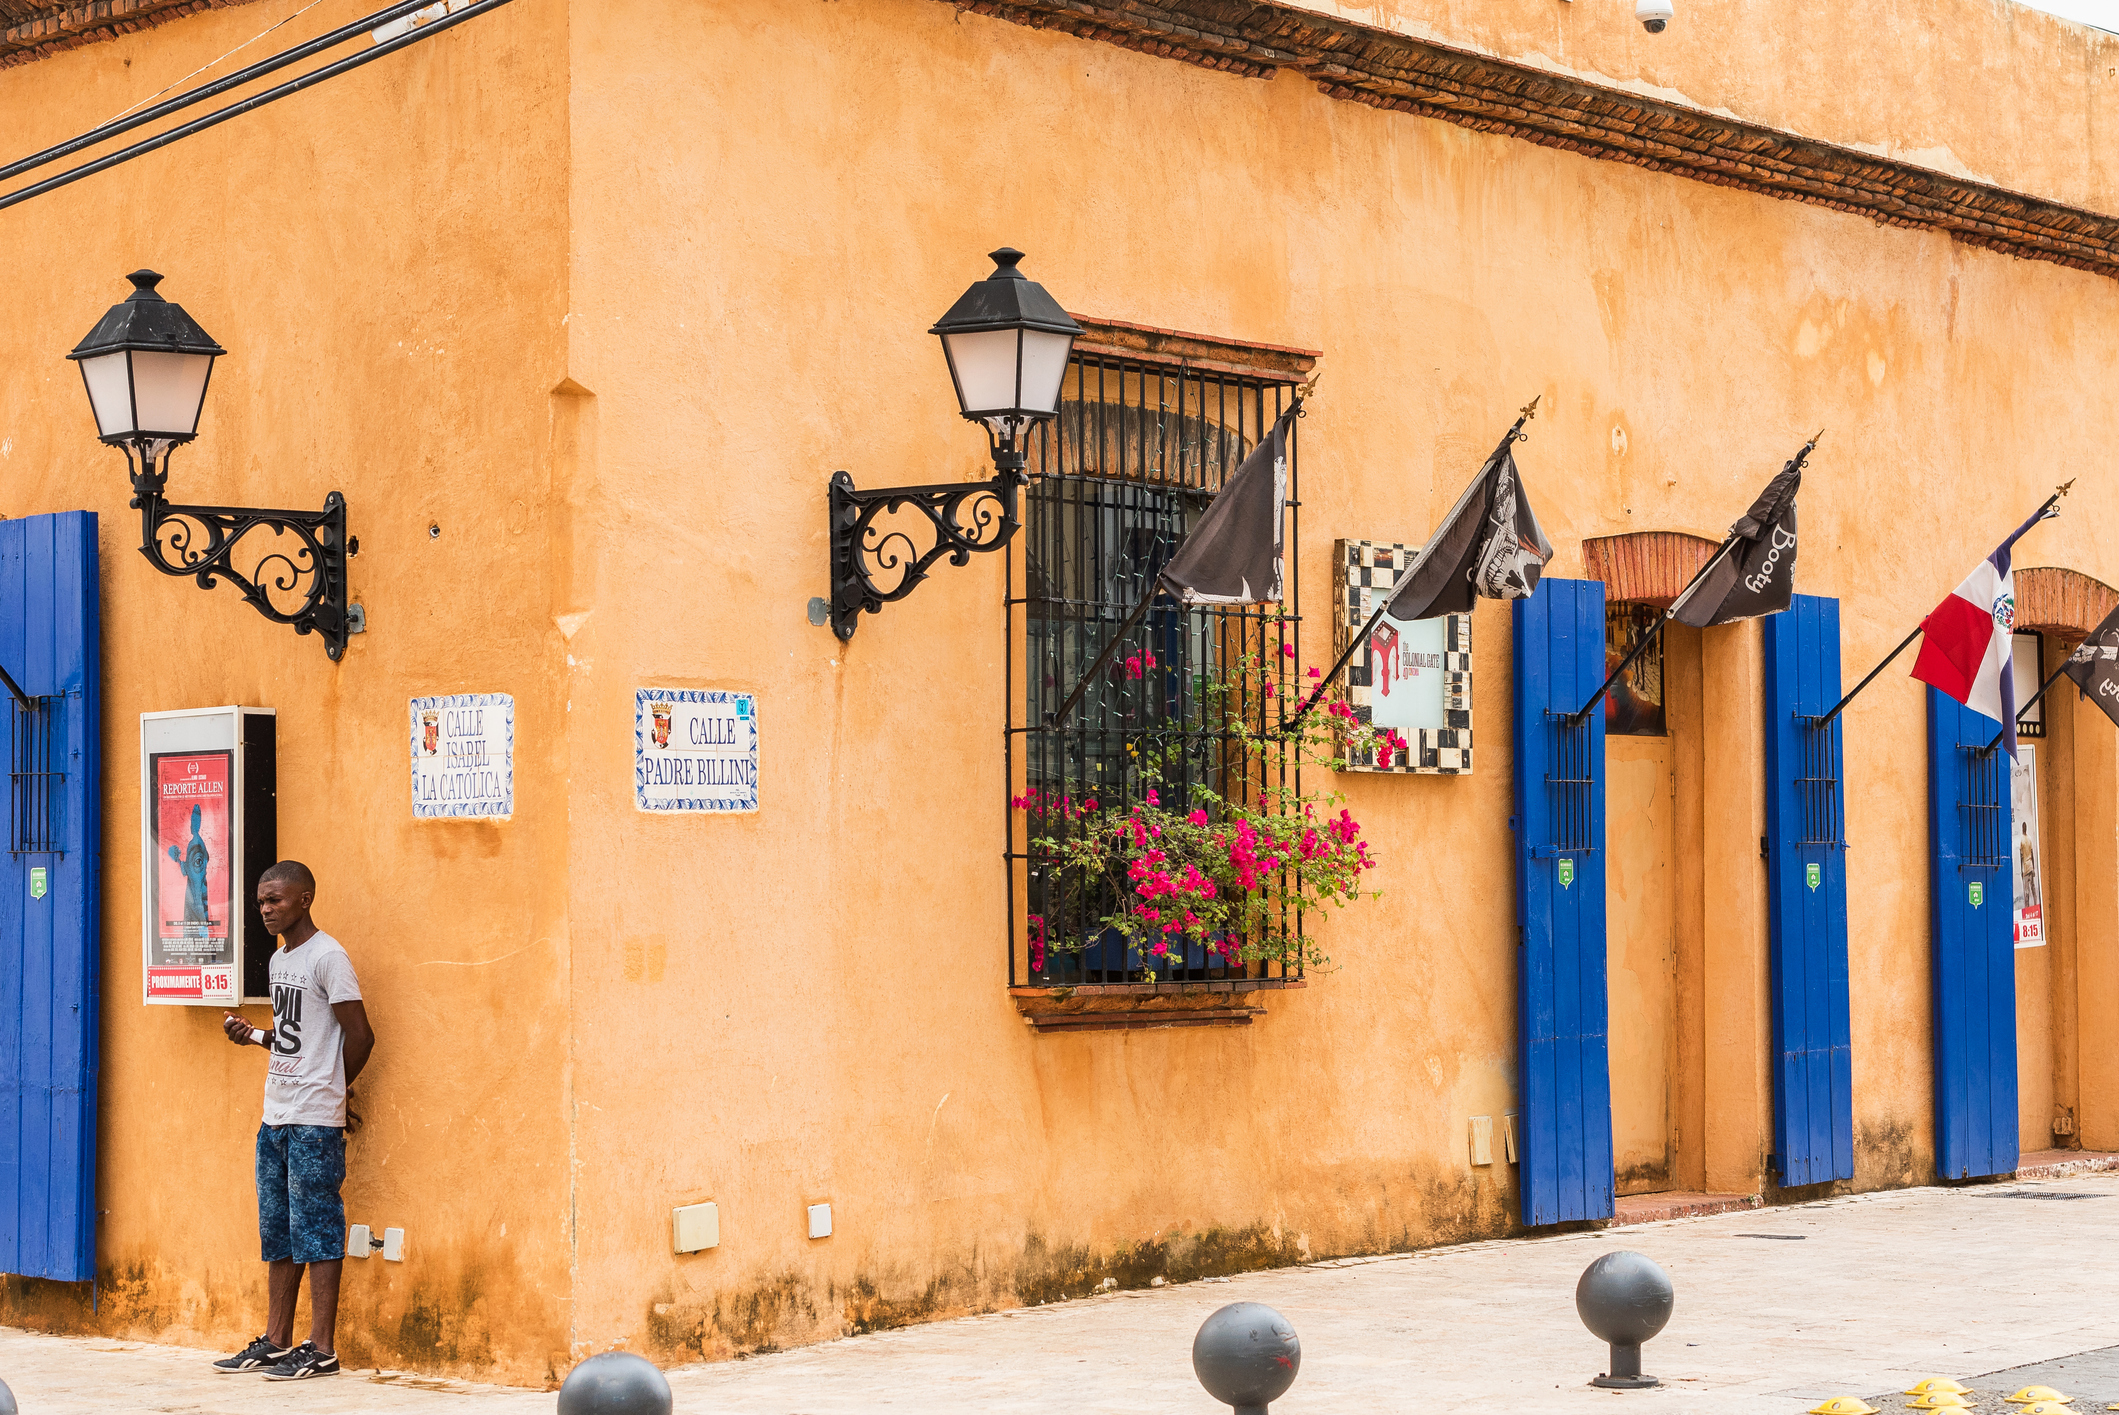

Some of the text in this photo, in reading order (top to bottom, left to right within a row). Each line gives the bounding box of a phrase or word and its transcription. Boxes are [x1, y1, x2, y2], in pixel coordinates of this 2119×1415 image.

[1745, 523, 1796, 594] Booty
[1403, 652, 1439, 669] COLONIAL GATE
[446, 709, 483, 738] CALLE
[690, 717, 736, 745] CALLE
[446, 740, 490, 769] ISABEL
[422, 767, 501, 801] LA CATÓLICA
[644, 757, 750, 786] PADRE BILLINI
[163, 781, 223, 795] REPORTE ALLEN
[2022, 924, 2039, 938] 8:15
[151, 974, 228, 990] PROXIMAMENTE 8:15
